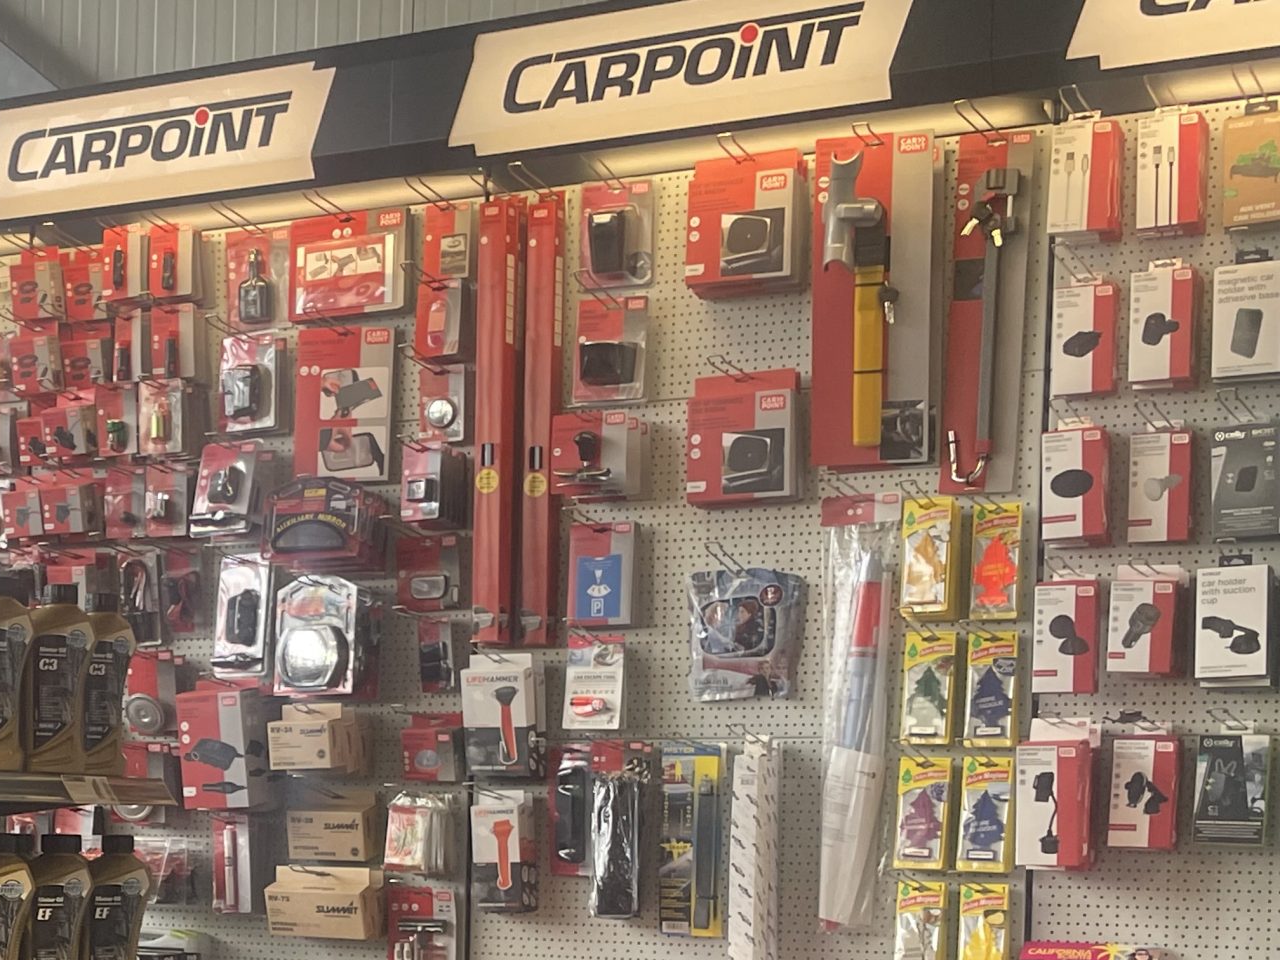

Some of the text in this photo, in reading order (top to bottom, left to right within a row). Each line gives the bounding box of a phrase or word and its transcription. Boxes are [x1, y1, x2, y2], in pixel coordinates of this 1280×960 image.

[900, 143, 927, 151] POINT
[1202, 577, 1246, 588] car holder
[1202, 586, 1256, 596] with suction
[1202, 597, 1218, 606] cup
[39, 658, 58, 671] C3
[89, 664, 106, 675] C3
[466, 675, 518, 684] LIFEHAMMER
[37, 908, 53, 920] EF
[94, 907, 110, 920] EF
